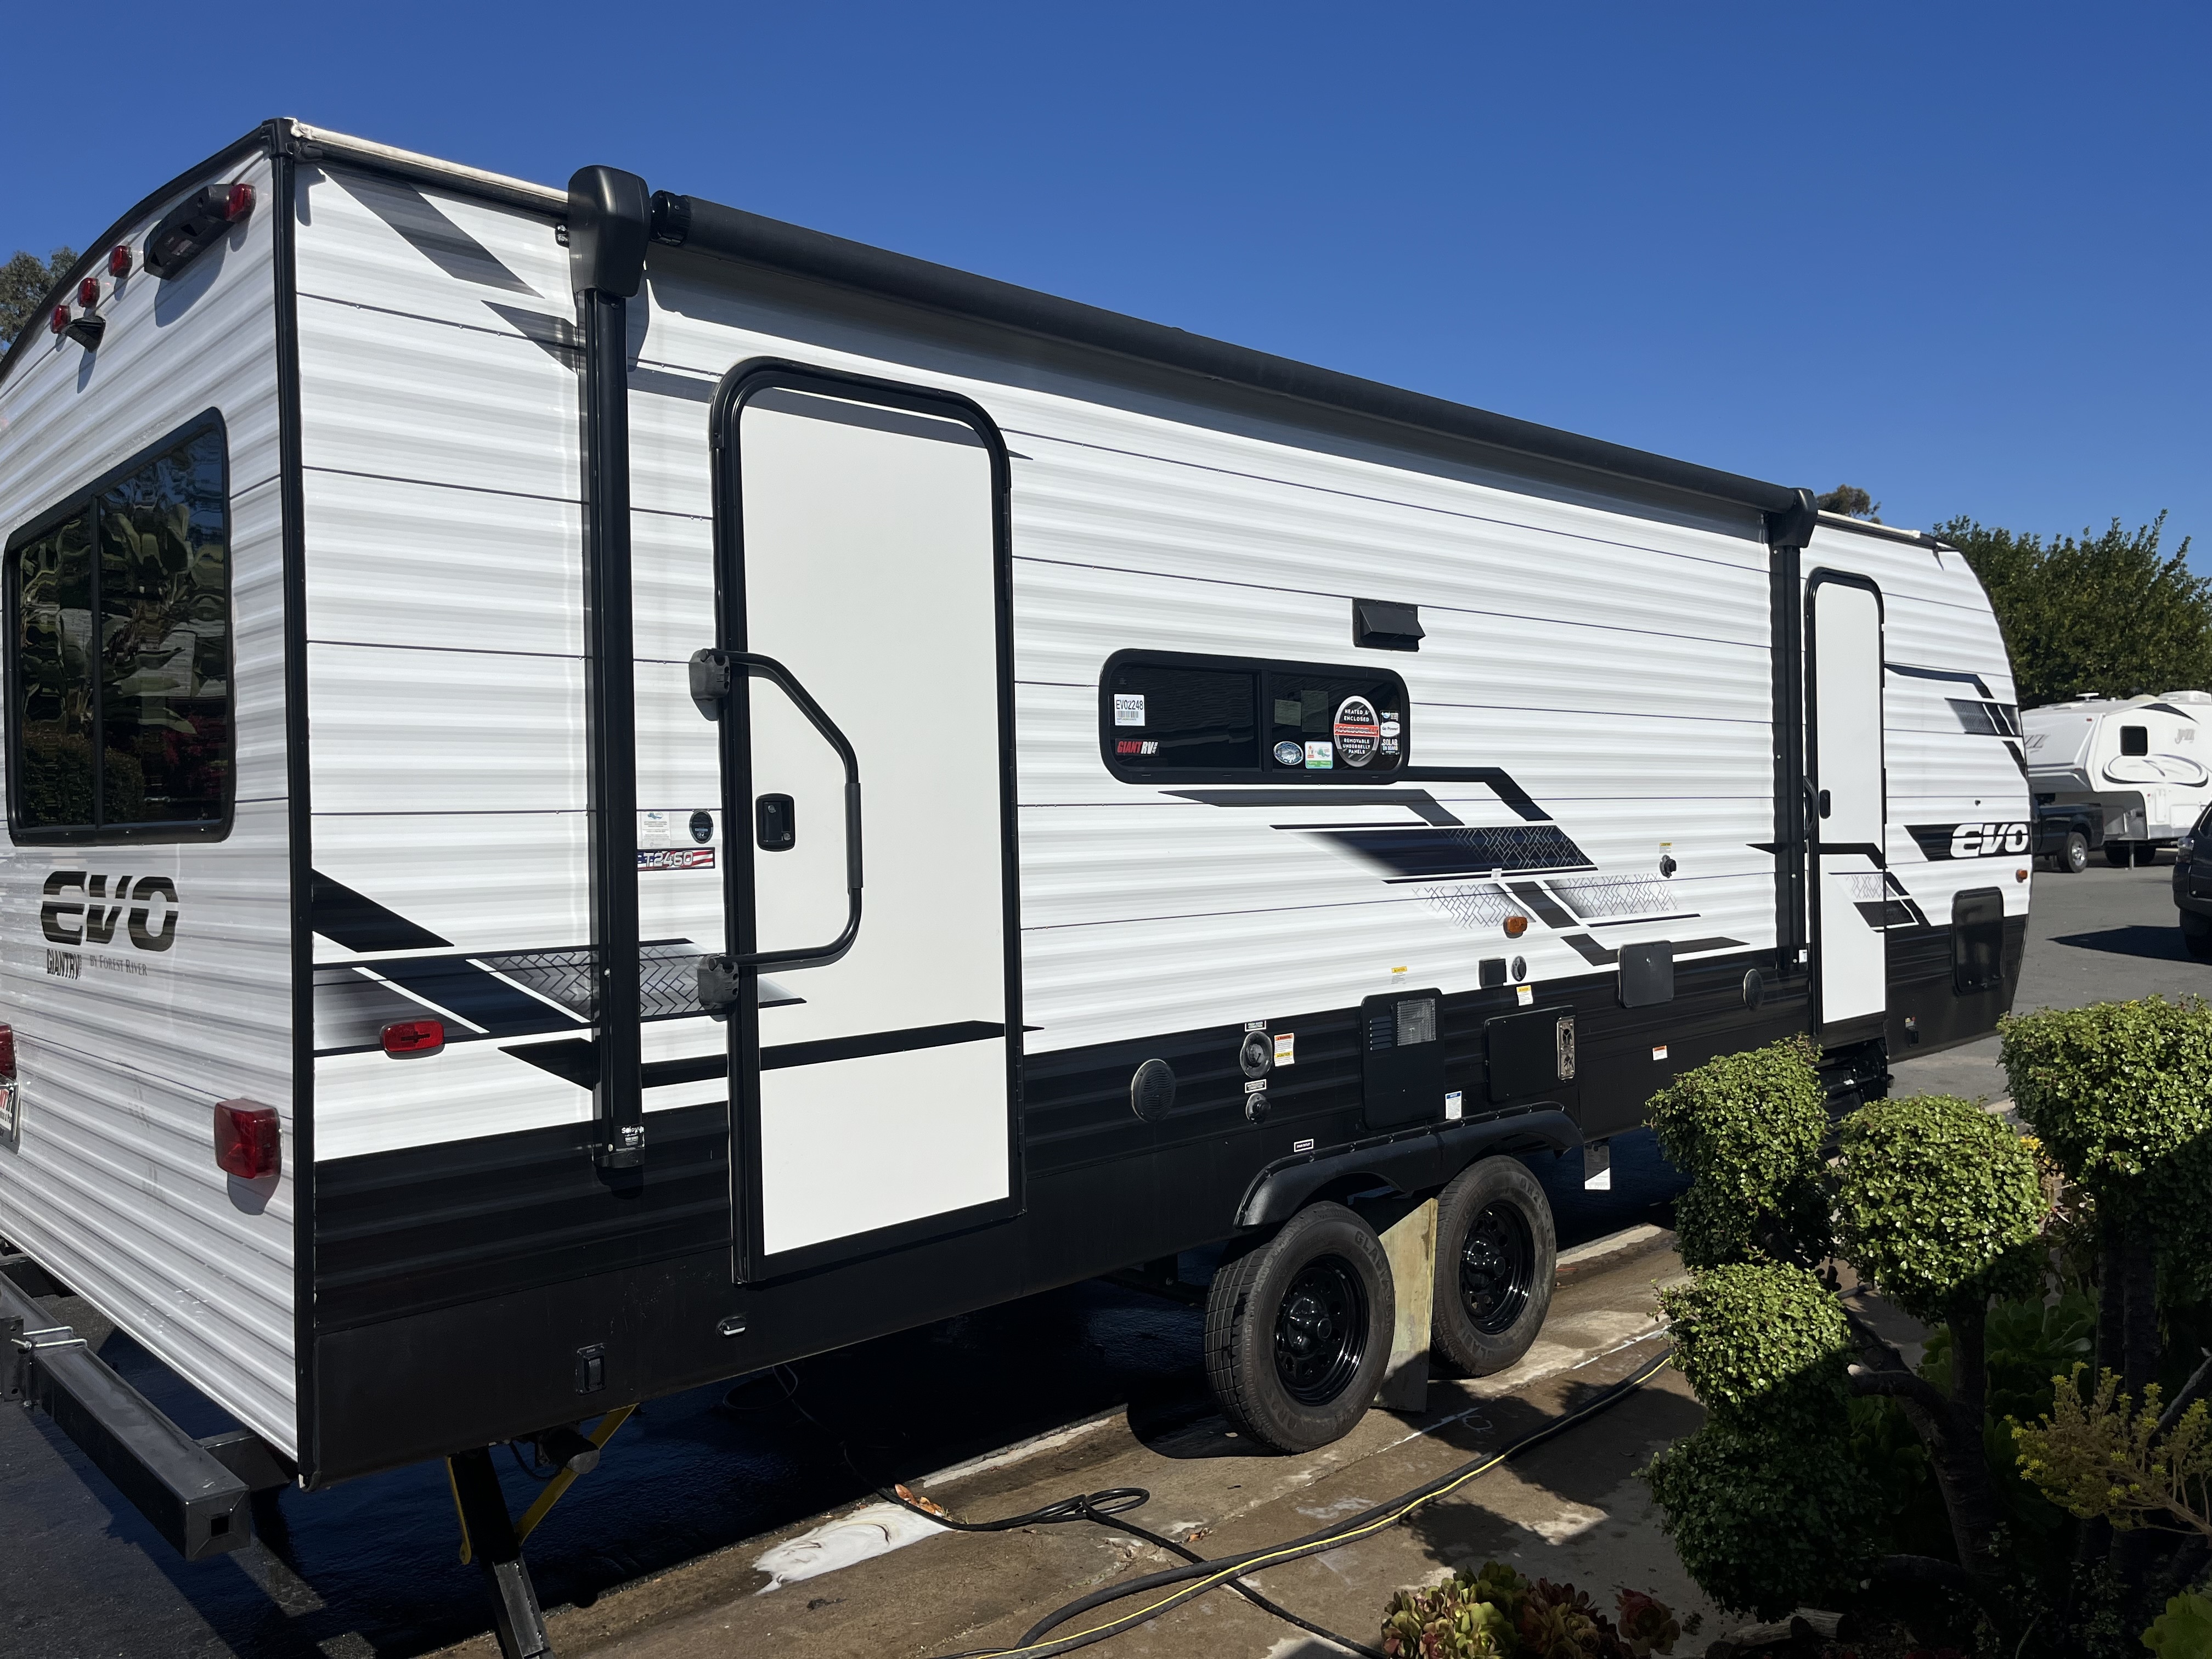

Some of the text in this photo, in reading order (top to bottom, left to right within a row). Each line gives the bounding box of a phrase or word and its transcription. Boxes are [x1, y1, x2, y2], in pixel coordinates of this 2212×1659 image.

[1950, 823, 2028, 858] EVO
[644, 851, 694, 867] T2460
[41, 871, 179, 952] EVO
